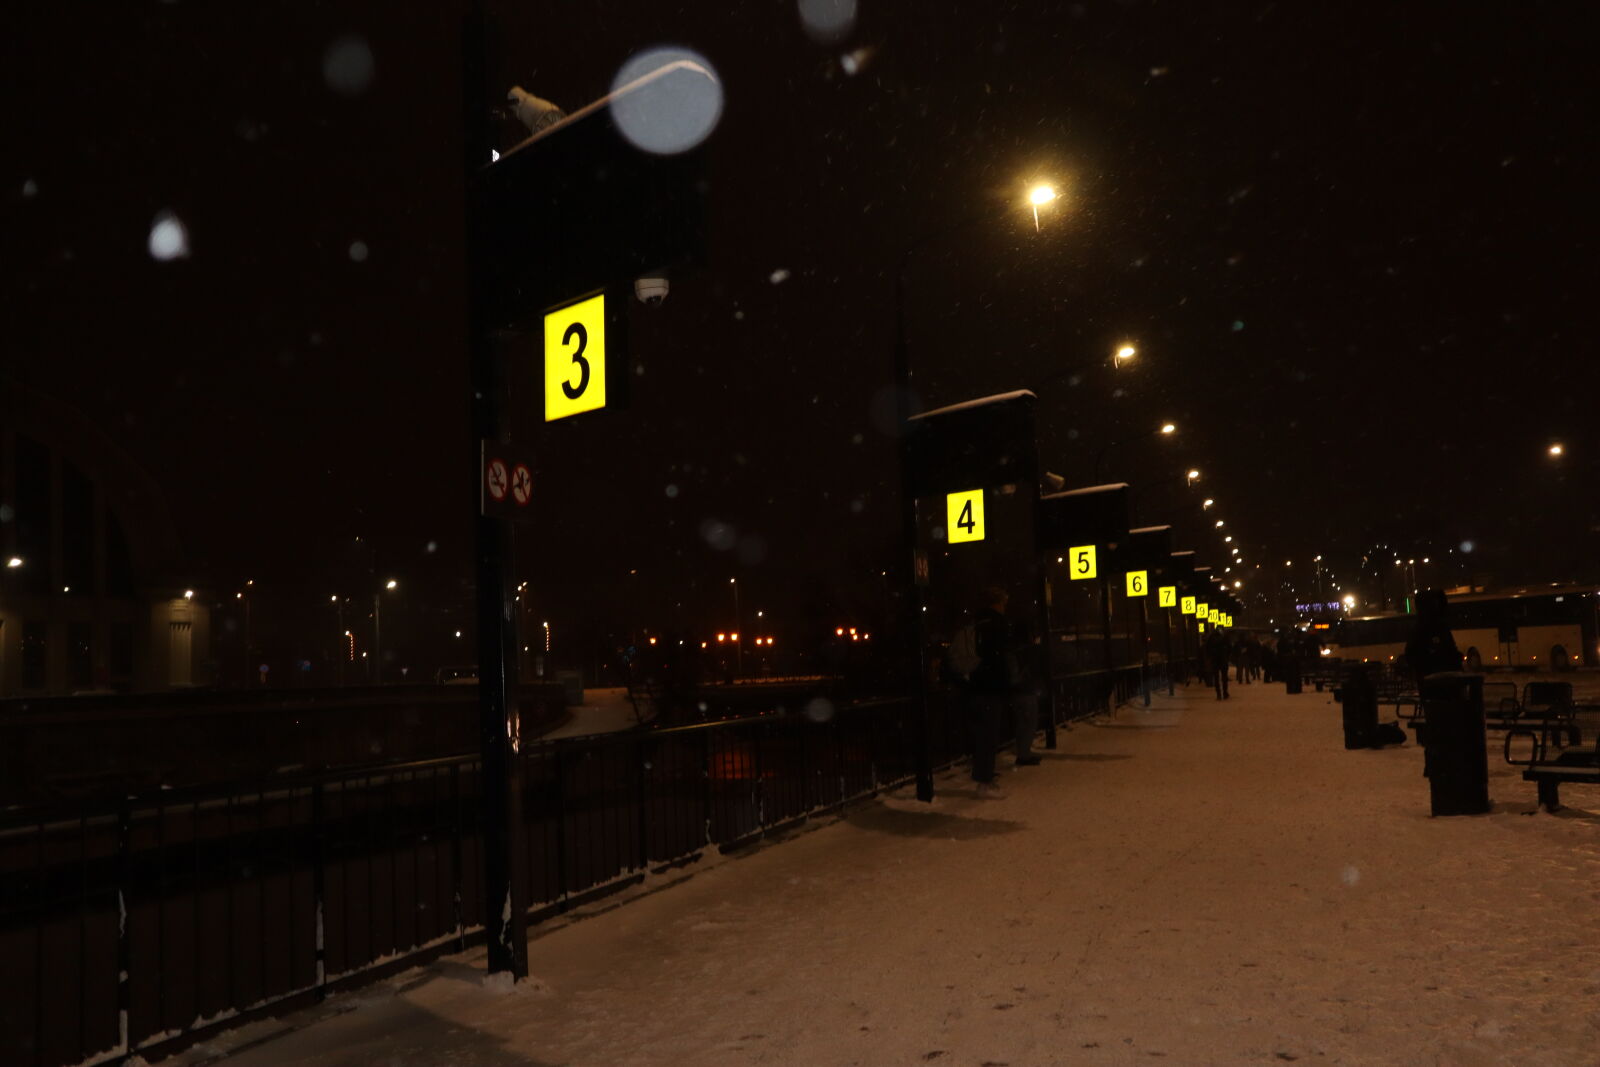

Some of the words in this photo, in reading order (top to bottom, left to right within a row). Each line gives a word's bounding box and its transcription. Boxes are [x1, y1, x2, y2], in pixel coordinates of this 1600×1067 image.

[562, 322, 590, 399] 3
[957, 499, 976, 534] 4
[1077, 551, 1090, 574] 5
[1132, 575, 1142, 593] 6
[1164, 590, 1171, 603] 7
[1185, 600, 1192, 611] 8
[1199, 606, 1205, 616] 9
